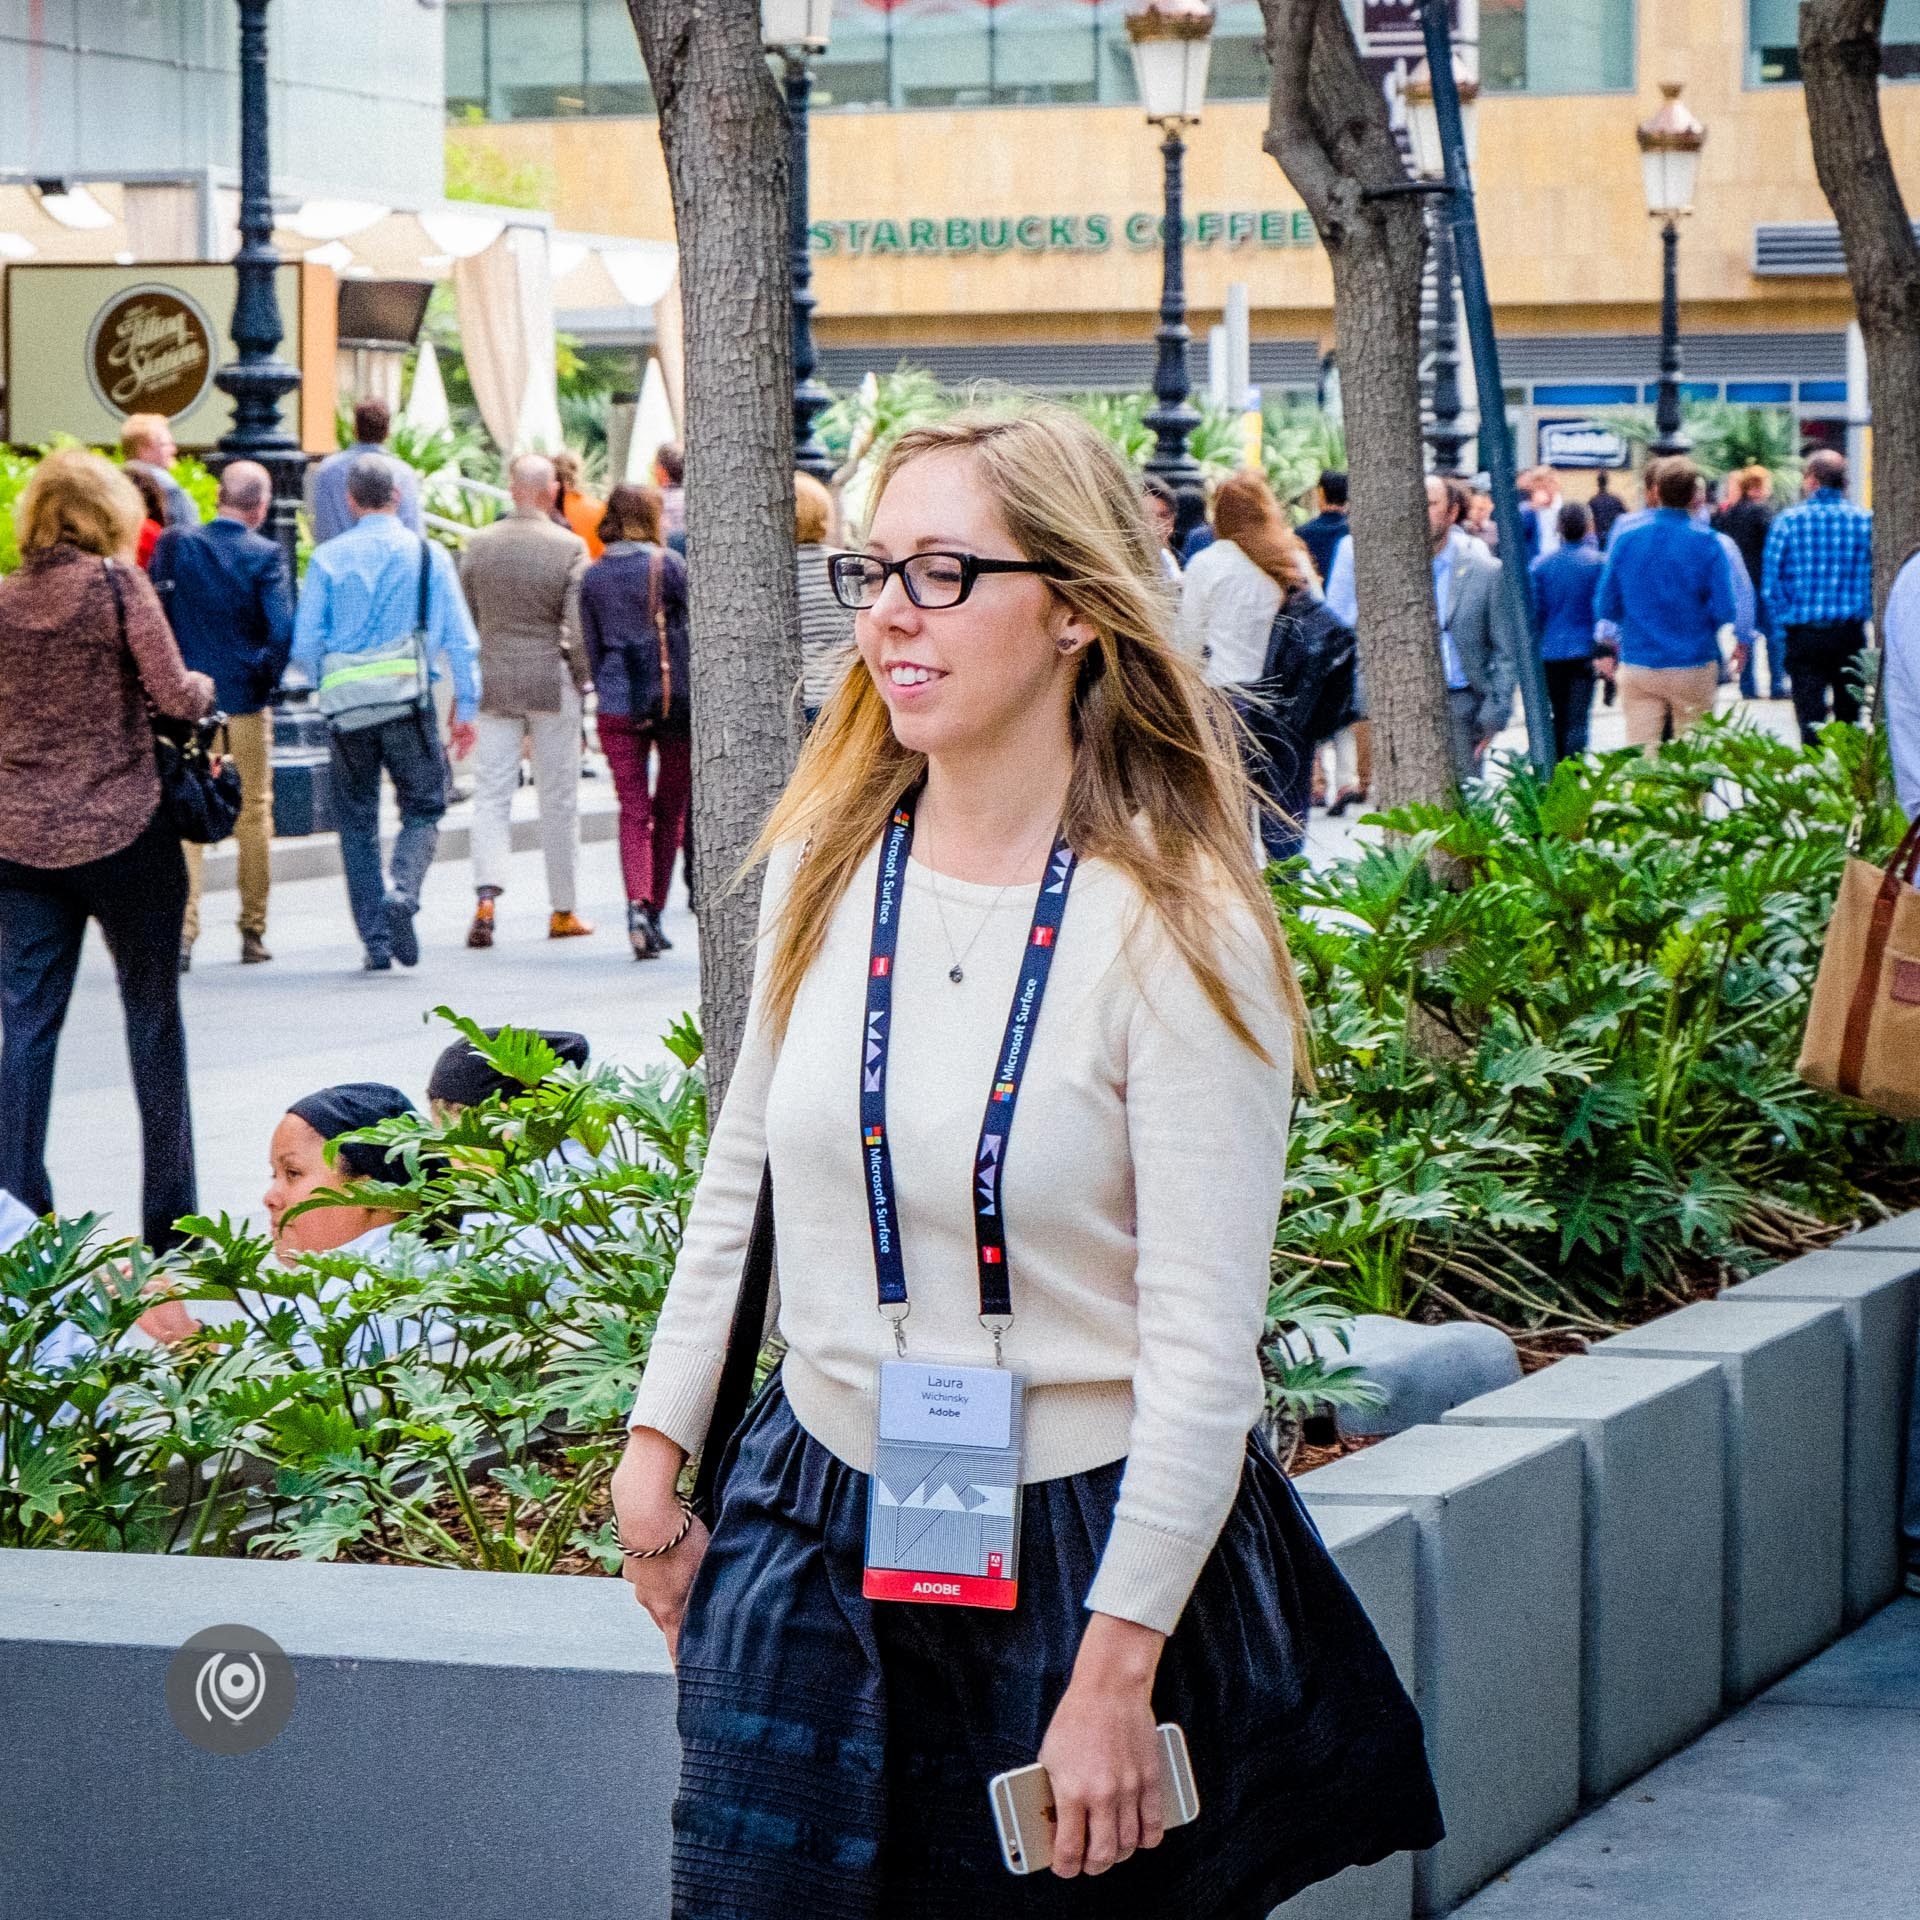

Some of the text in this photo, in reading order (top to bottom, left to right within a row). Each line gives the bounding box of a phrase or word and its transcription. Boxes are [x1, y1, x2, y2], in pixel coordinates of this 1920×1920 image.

[807, 213, 1109, 254] STARBUCKS
[879, 825, 906, 925] Microsoft Surface
[1001, 978, 1037, 1081] Microsoft Surface
[869, 1148, 890, 1254] Microsoft Surface
[928, 1375, 963, 1389] Laura
[928, 1407, 961, 1418] Adobe
[912, 1581, 962, 1596] ADOBE
